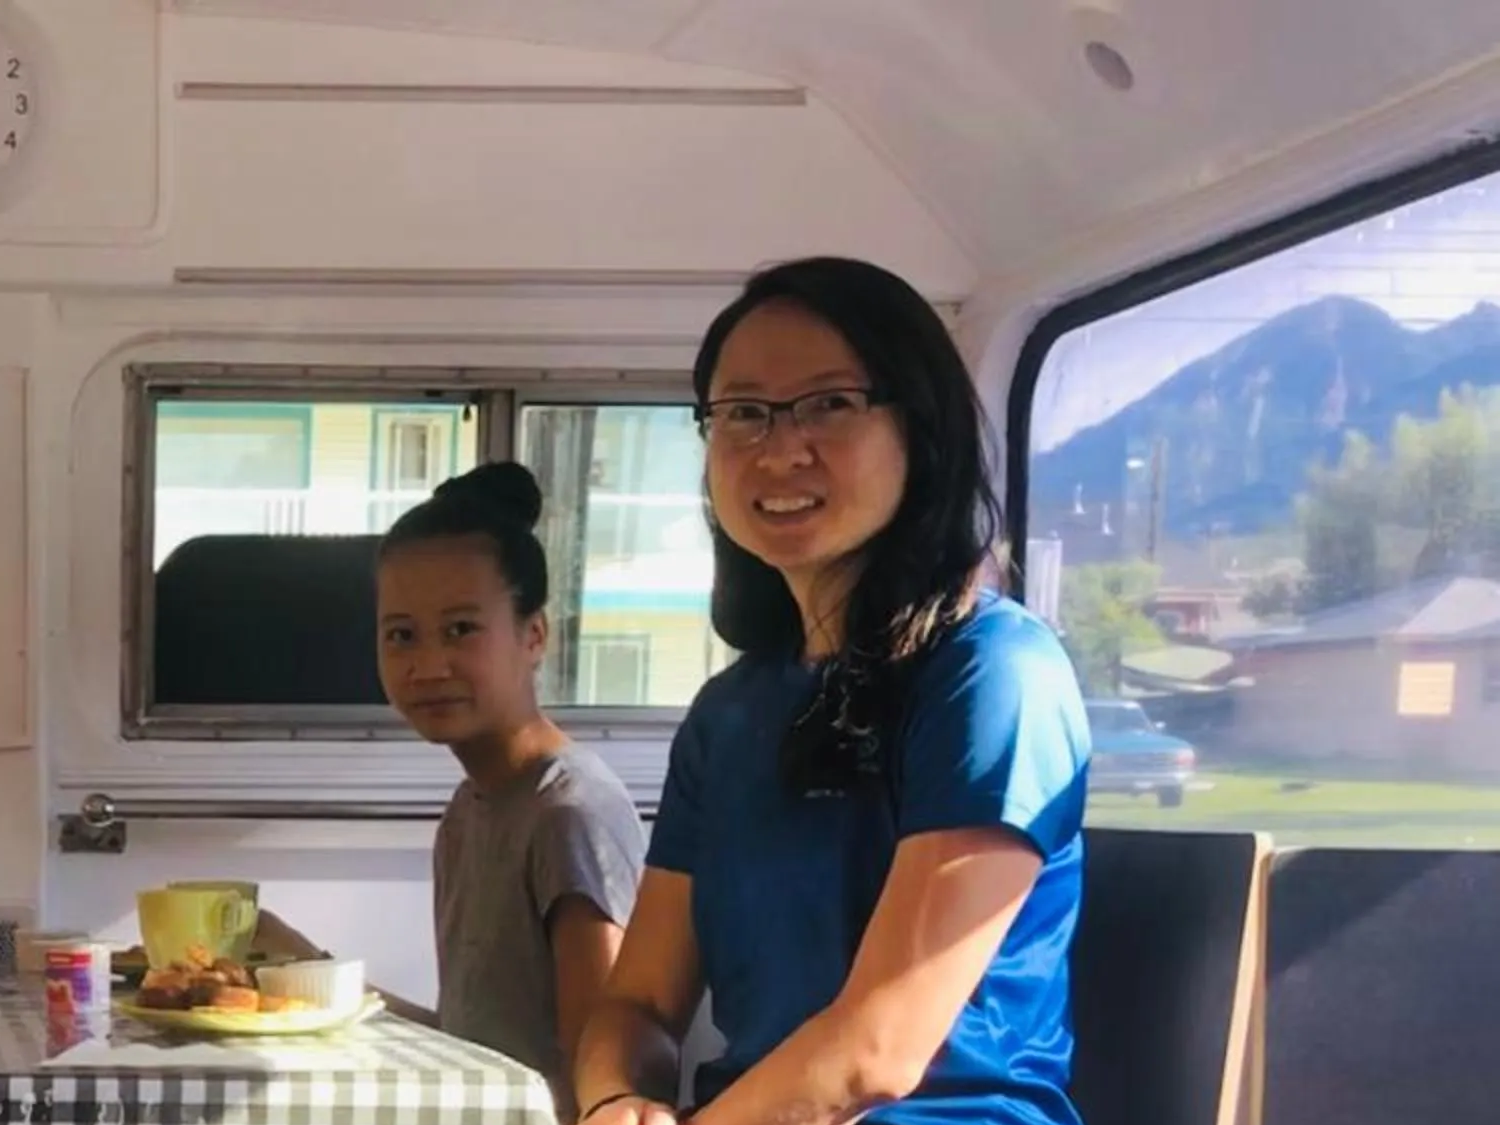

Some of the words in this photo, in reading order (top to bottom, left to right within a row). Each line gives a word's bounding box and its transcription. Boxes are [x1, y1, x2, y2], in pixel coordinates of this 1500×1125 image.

[6, 58, 20, 79] 2
[15, 94, 28, 115] 3
[4, 131, 17, 149] 4
